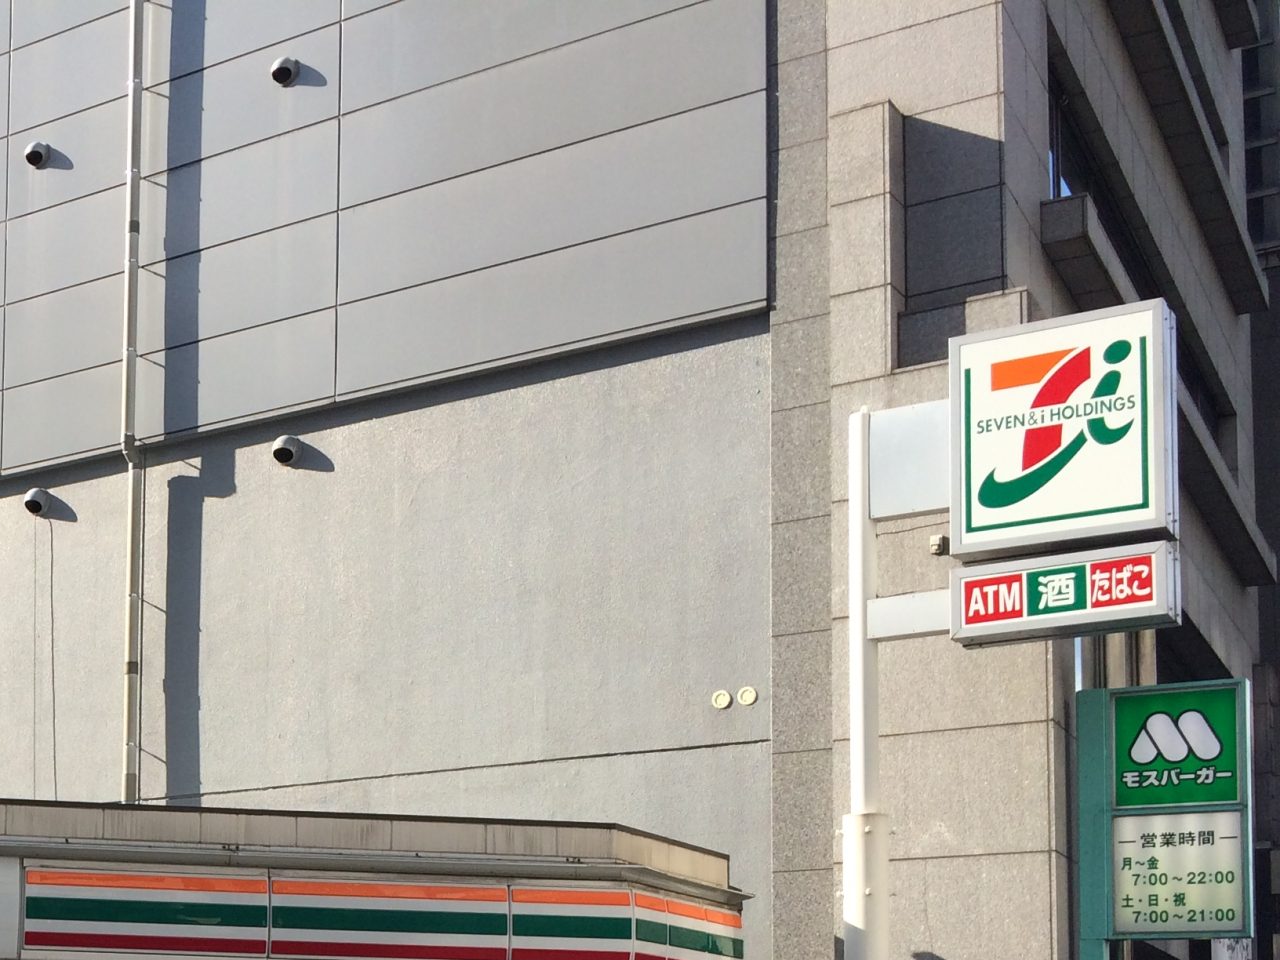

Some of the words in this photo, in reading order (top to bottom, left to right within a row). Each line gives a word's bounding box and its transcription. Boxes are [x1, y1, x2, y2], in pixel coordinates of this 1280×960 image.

[1050, 395, 1135, 422] HOLDINGS
[968, 581, 1020, 617] ATM
[1037, 573, 1076, 610] 酒
[1091, 563, 1152, 604] たばこ
[1122, 766, 1232, 788] モスバーガー
[1140, 831, 1215, 848] 営業時間
